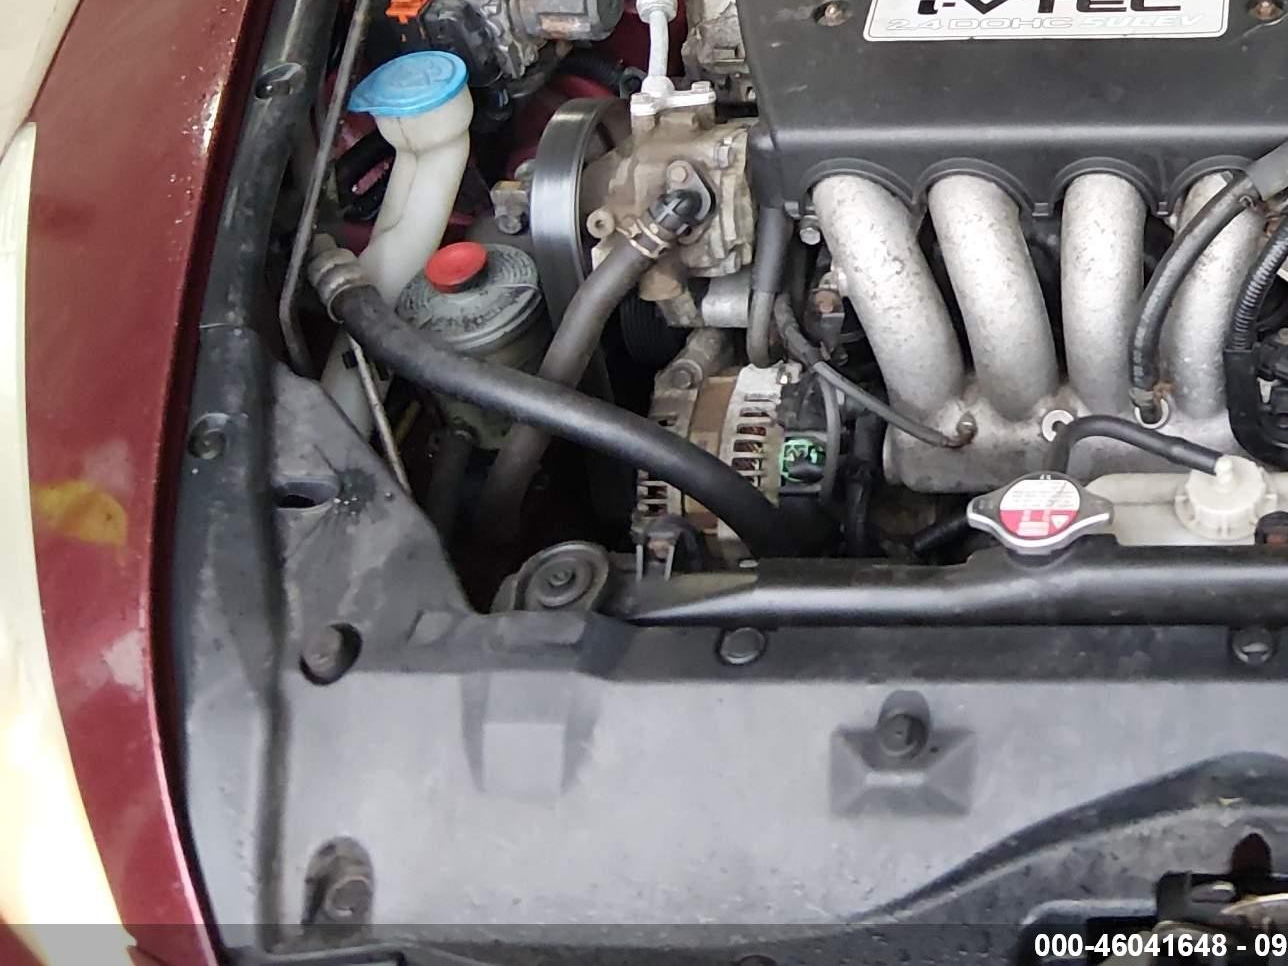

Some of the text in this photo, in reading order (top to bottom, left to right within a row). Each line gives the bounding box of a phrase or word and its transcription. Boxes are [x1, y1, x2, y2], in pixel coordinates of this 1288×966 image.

[886, 14, 1203, 31] 2.4 DOHC SULEV
